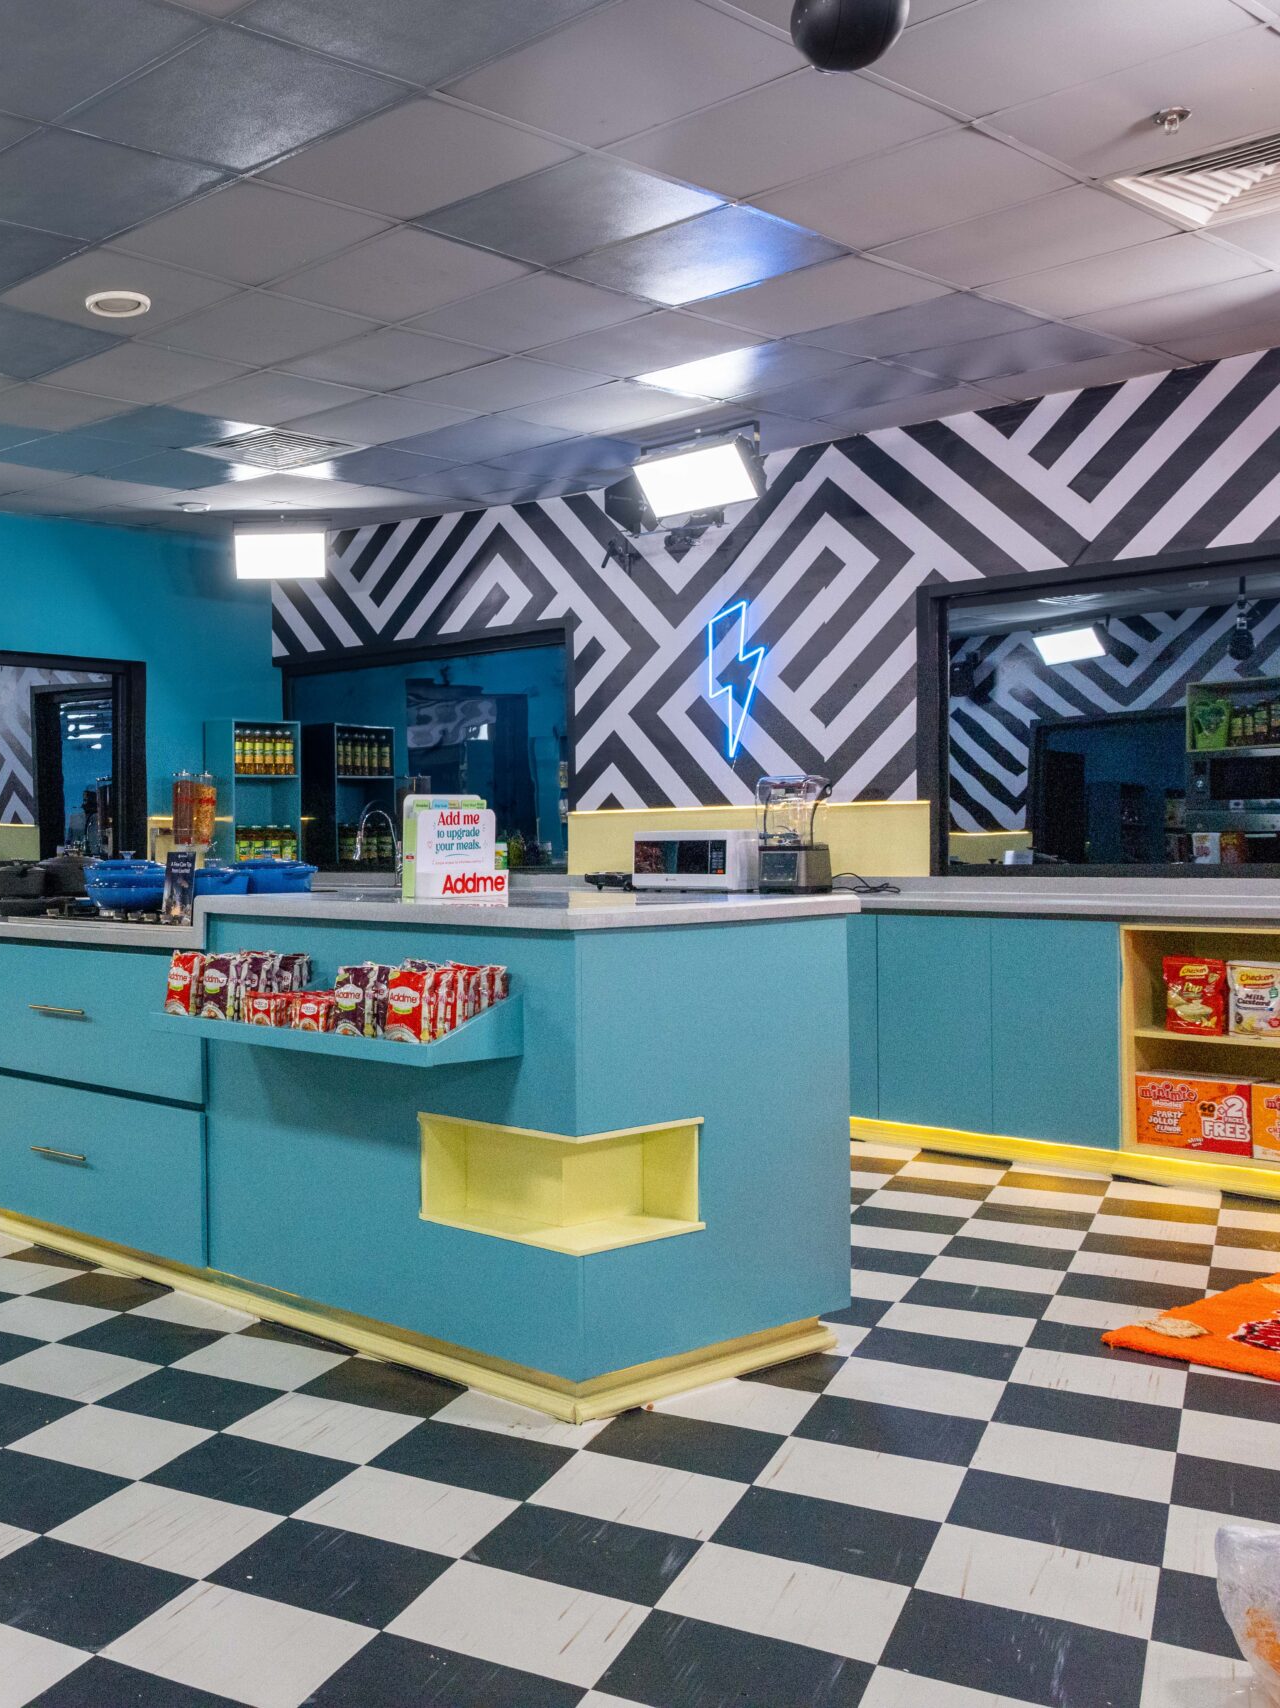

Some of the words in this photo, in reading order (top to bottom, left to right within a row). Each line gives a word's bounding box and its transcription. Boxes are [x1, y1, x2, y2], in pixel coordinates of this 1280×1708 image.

[437, 811, 461, 826] Add
[463, 813, 480, 824] me
[437, 829, 444, 838] to
[446, 827, 480, 840] upgrade
[435, 842, 454, 854] your
[456, 840, 481, 850] meals.
[442, 872, 505, 895] Addme
[1184, 982, 1203, 992] Pap
[336, 991, 360, 999] Addme
[389, 993, 418, 1004] Addme
[1237, 998, 1271, 1006] Custard
[1140, 1082, 1197, 1101] minimie
[1156, 1110, 1184, 1118] PARTY
[1149, 1116, 1179, 1126] JOLLOF
[1202, 1120, 1248, 1139] FREE
